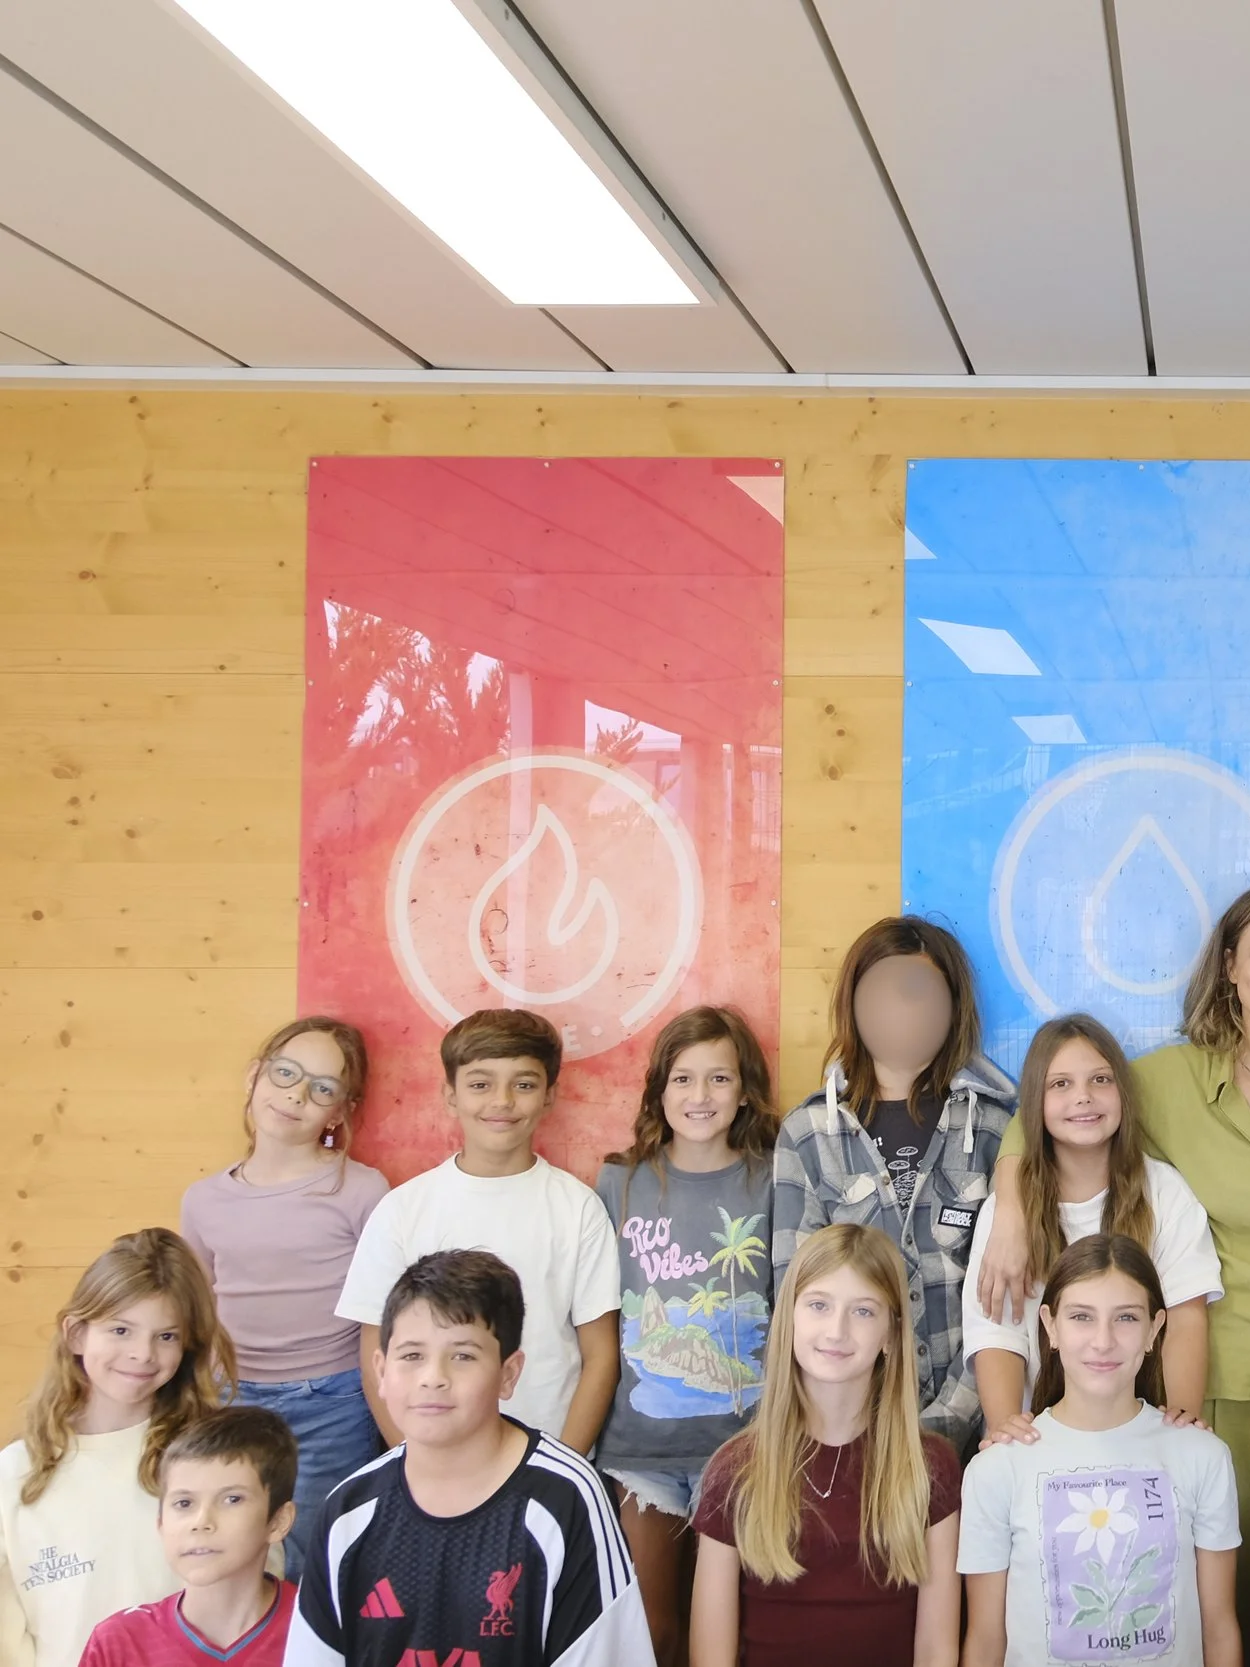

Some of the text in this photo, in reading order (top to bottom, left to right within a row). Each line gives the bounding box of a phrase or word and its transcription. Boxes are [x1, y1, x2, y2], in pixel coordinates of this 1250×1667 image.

[622, 1216, 673, 1258] Rio
[640, 1242, 709, 1284] Vibes
[1048, 1478, 1127, 1492] My Favourite Place
[47, 1559, 96, 1583] SOCIETY
[1087, 1625, 1167, 1651] Long Hug
